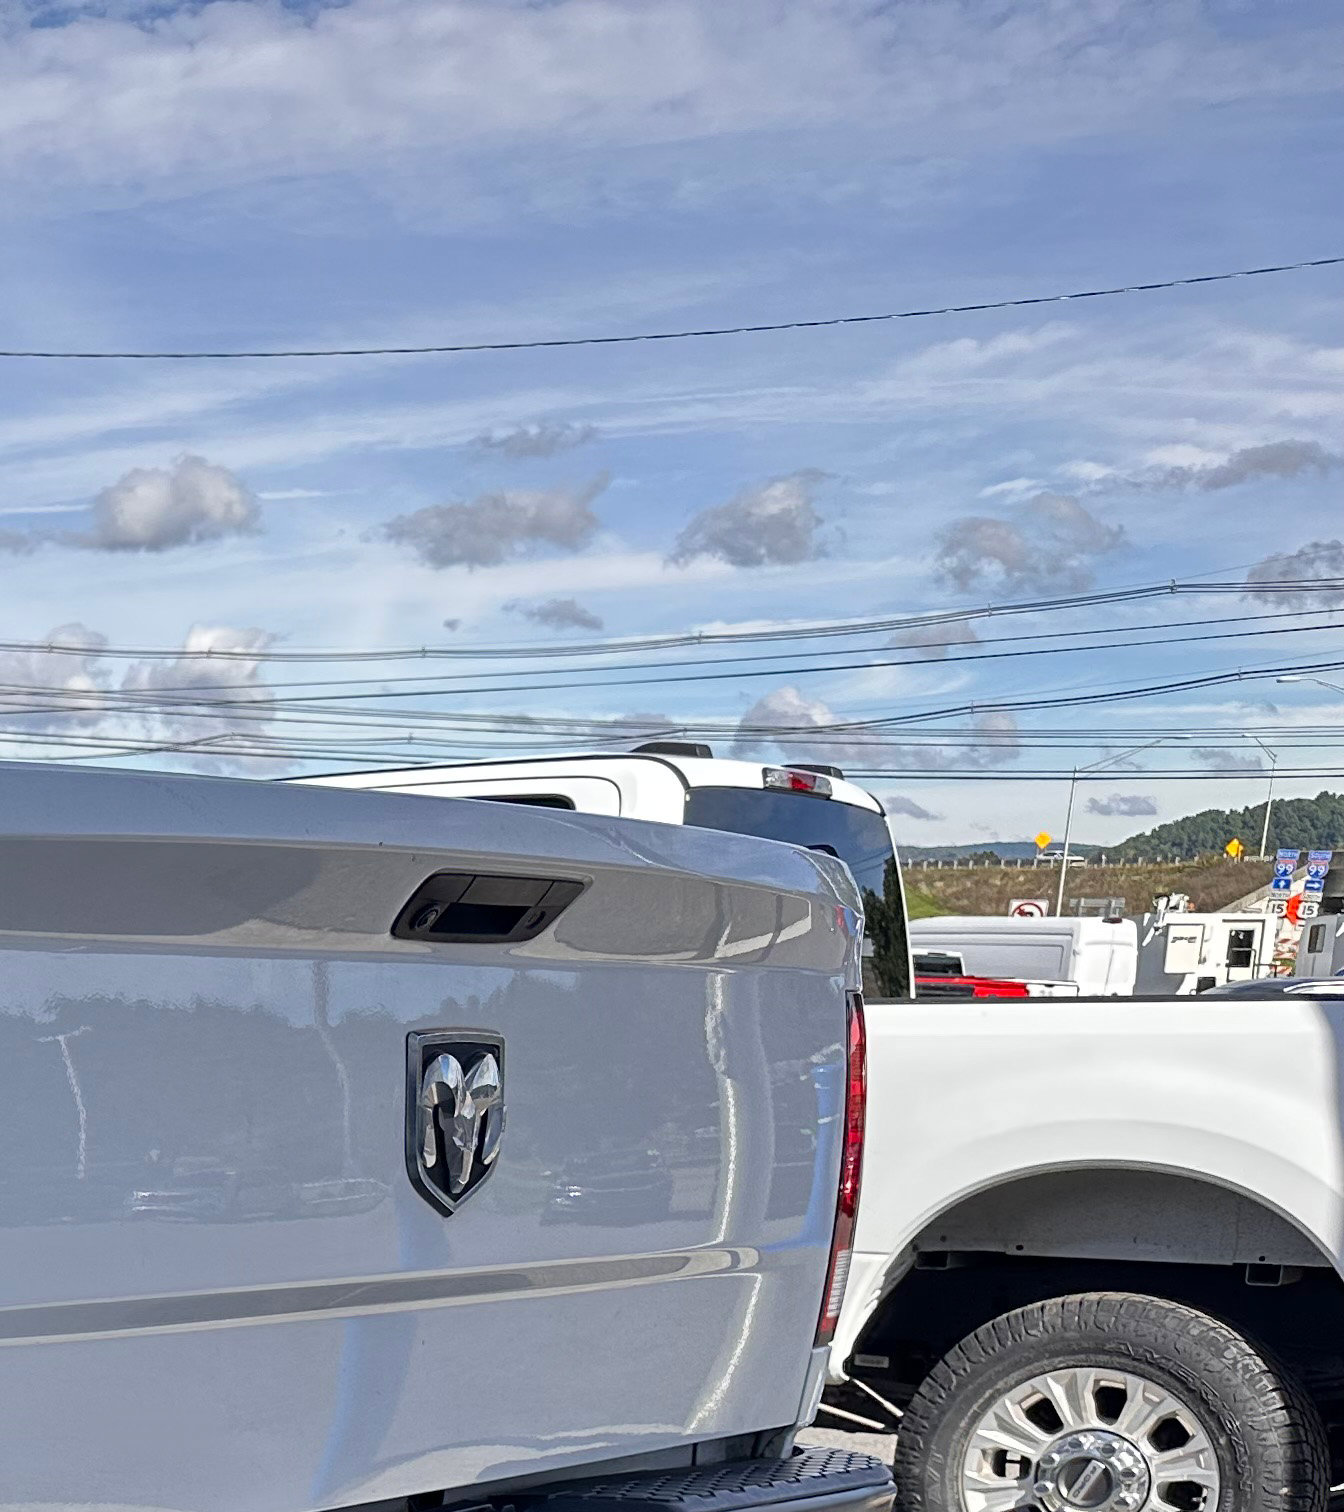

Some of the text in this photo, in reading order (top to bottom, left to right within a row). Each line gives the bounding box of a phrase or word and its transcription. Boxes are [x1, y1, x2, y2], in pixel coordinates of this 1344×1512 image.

[1277, 863, 1294, 875] 99
[1308, 865, 1326, 876] 99
[1271, 903, 1285, 914] 15
[1301, 905, 1315, 916] 15
